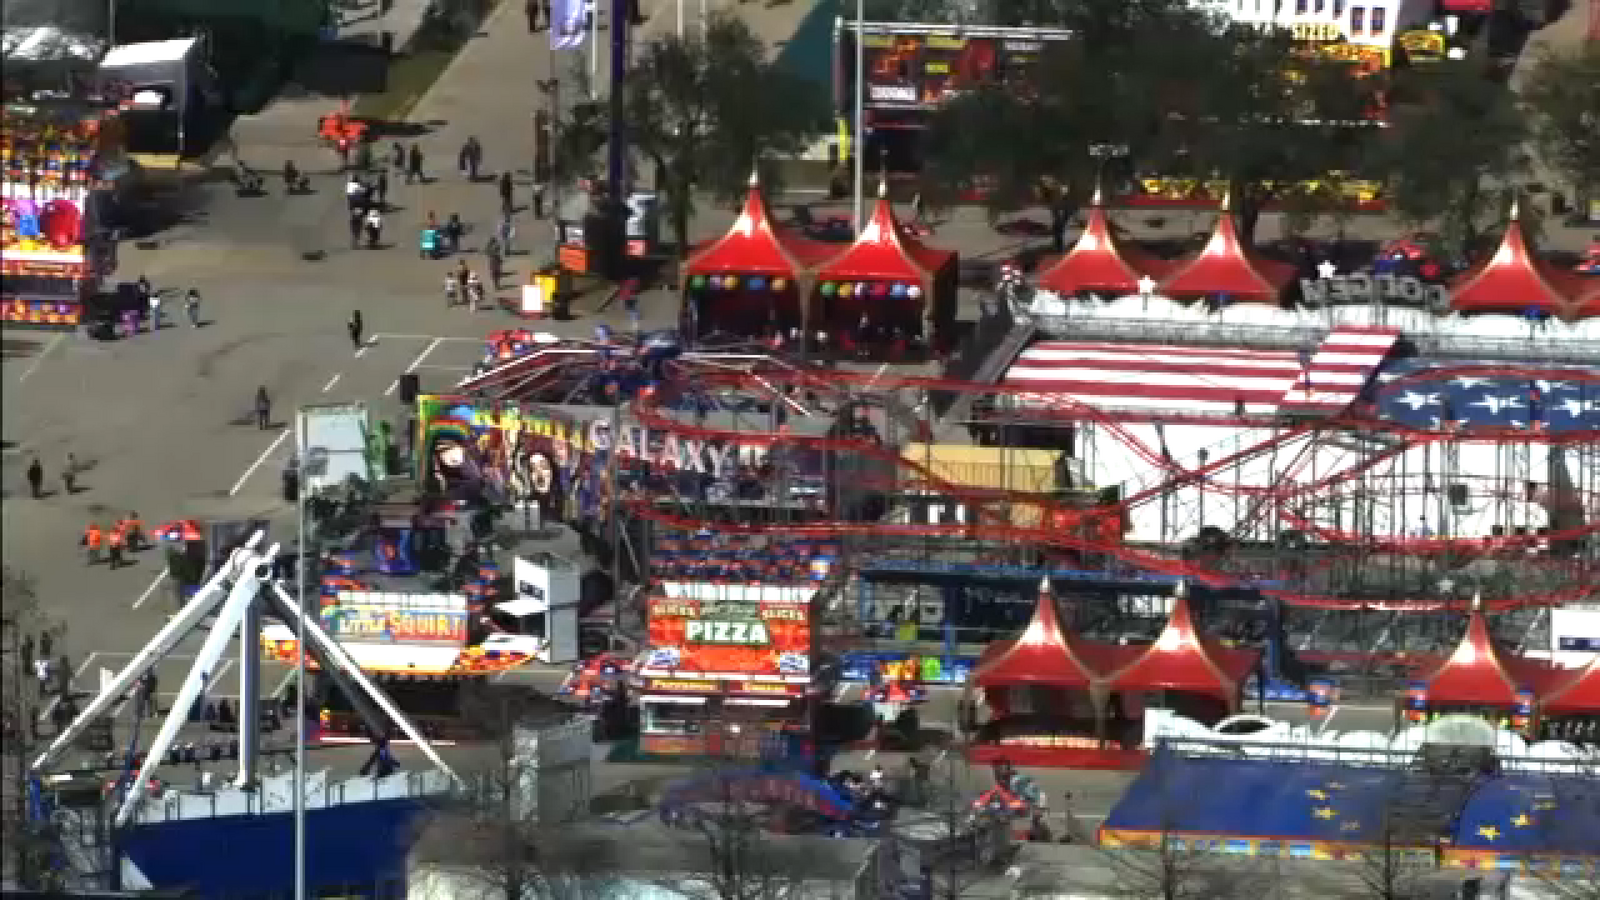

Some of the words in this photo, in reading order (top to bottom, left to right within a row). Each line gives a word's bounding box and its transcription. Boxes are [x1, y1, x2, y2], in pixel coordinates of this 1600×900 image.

[589, 418, 730, 478] GALAXY
[392, 611, 463, 636] SQUIRT
[686, 619, 769, 644] PIZZA
